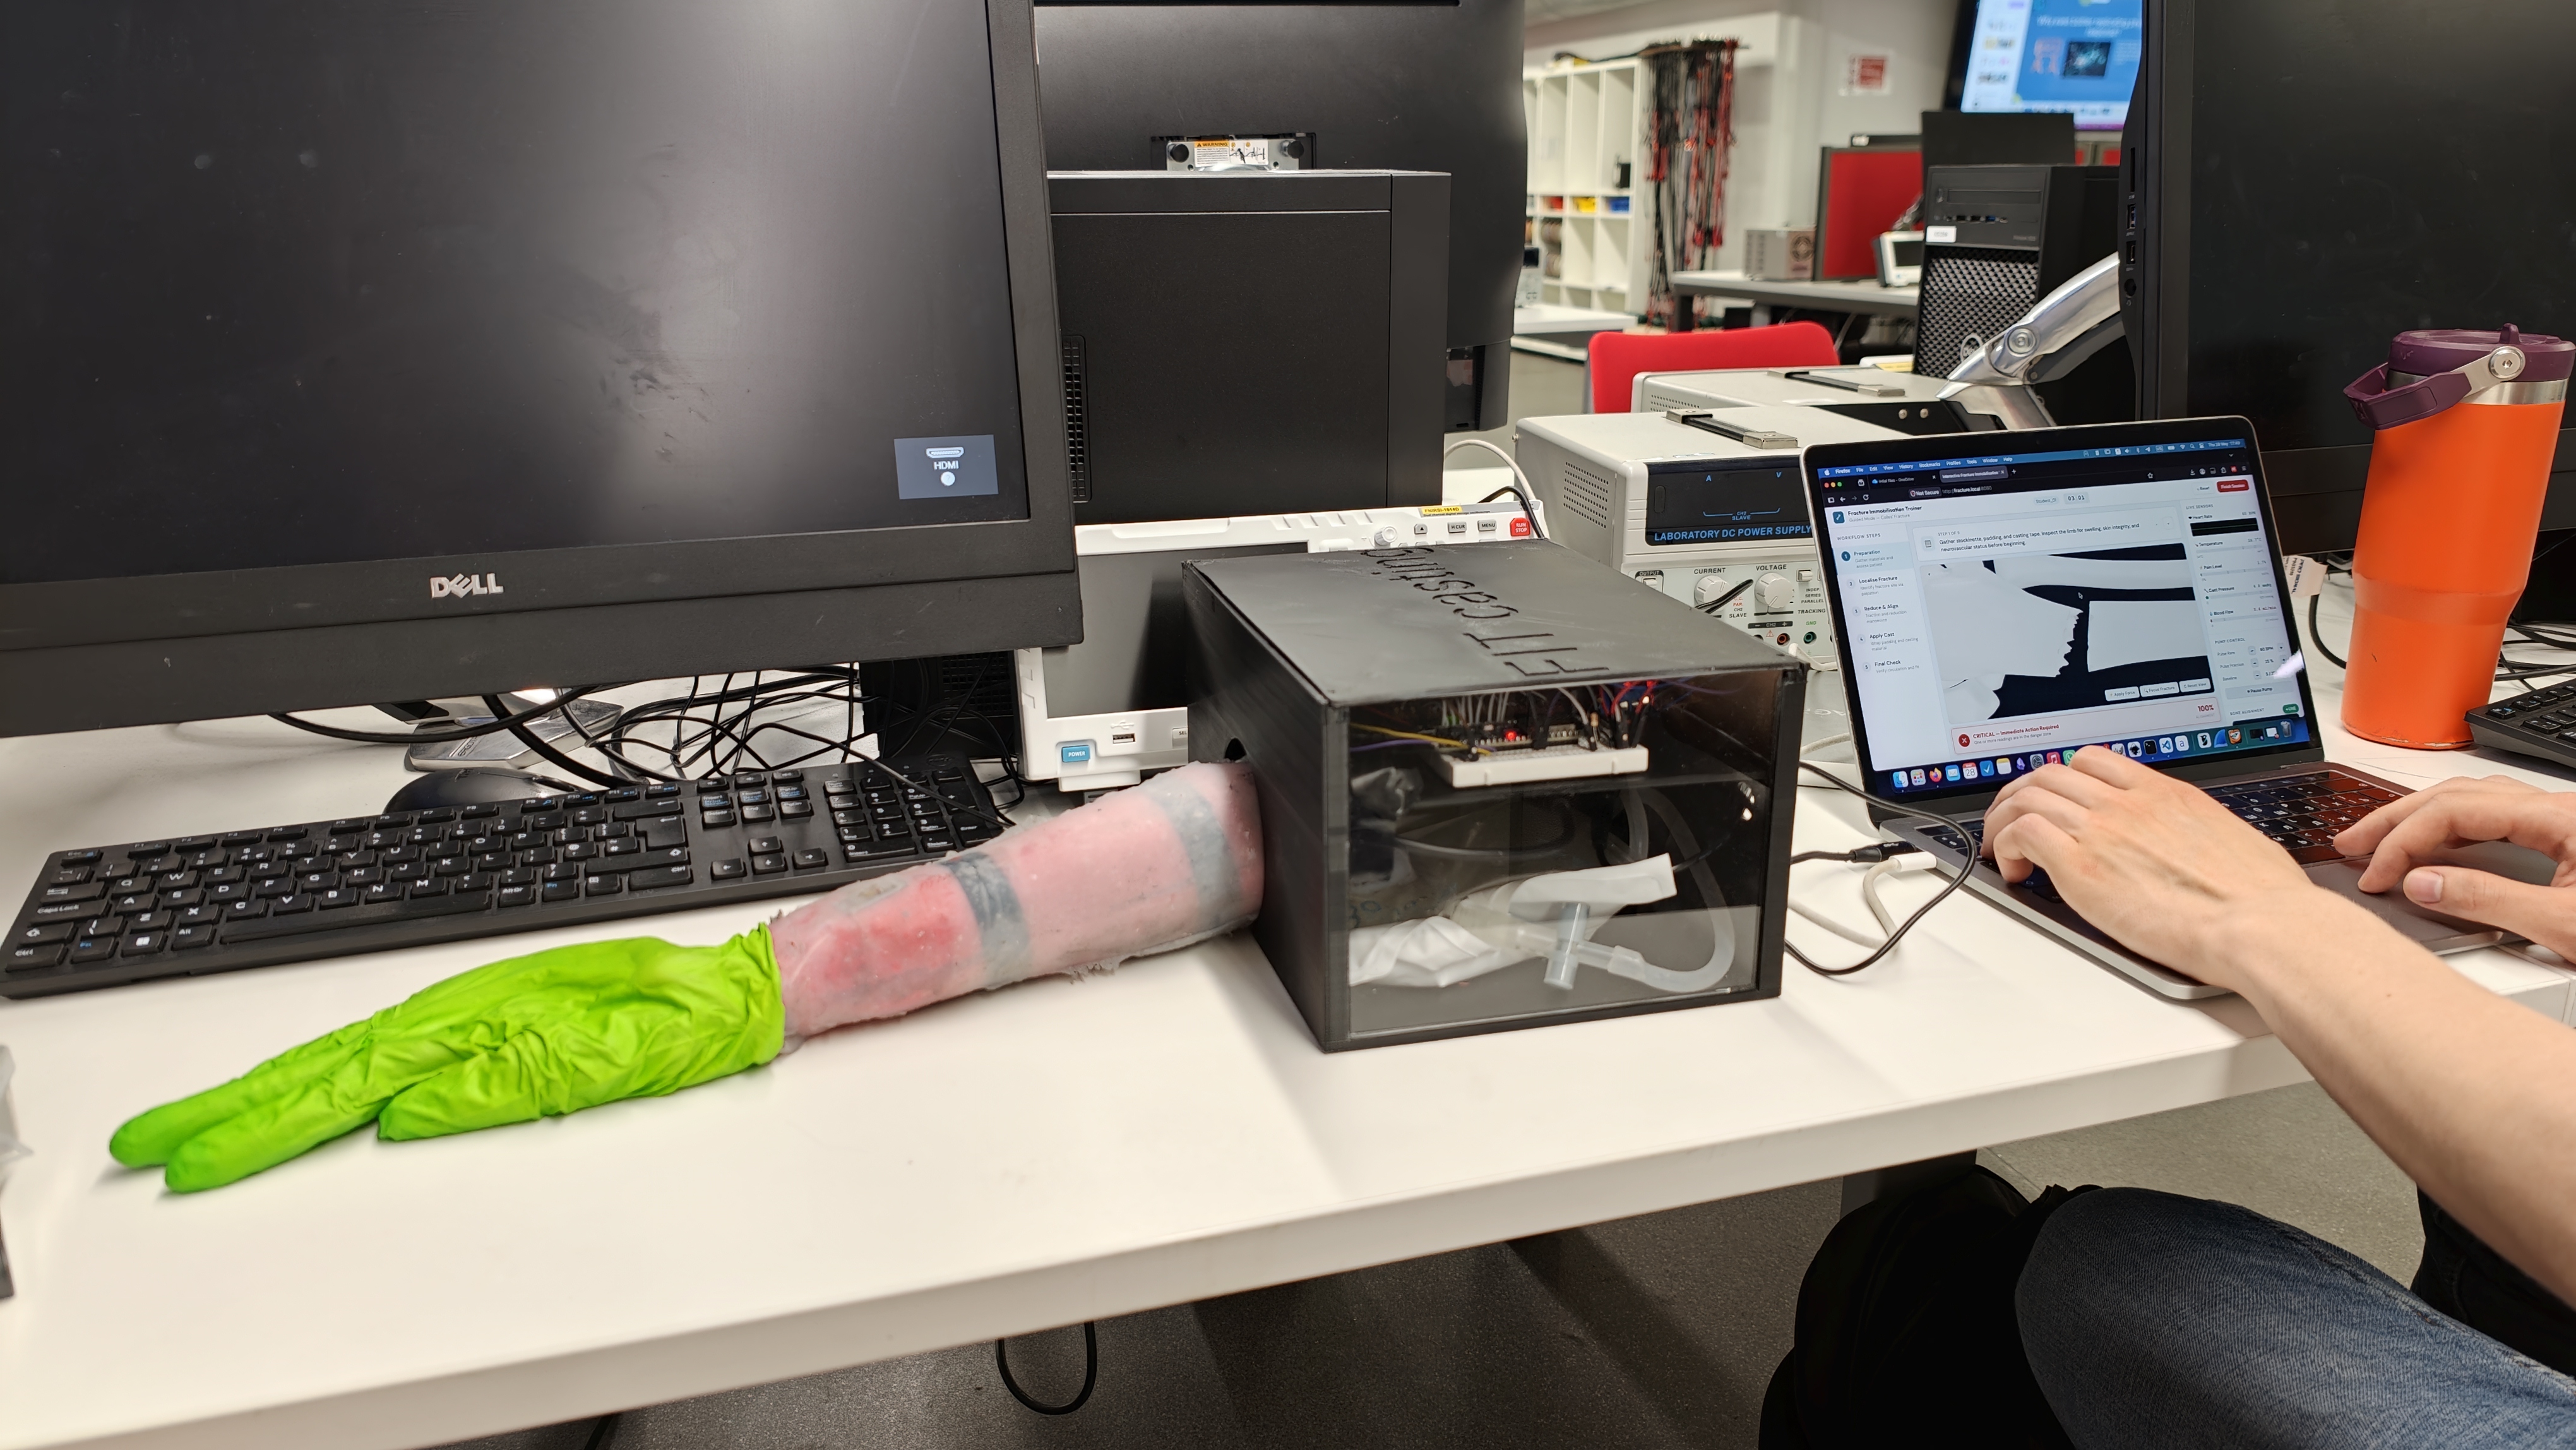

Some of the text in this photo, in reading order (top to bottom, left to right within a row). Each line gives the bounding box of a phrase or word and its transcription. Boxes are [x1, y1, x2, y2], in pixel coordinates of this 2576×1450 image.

[933, 460, 959, 470] HDMI
[1869, 506, 1905, 515] Immobilisation
[1654, 525, 1811, 541] LABORATORY DC POWER SUPPLY
[430, 573, 504, 599] DELL
[1462, 633, 1609, 677] FIT
[2197, 704, 2214, 712] 100%
[1965, 768, 1976, 777] 28
[169, 873, 184, 881] W
[121, 879, 133, 887] Q
